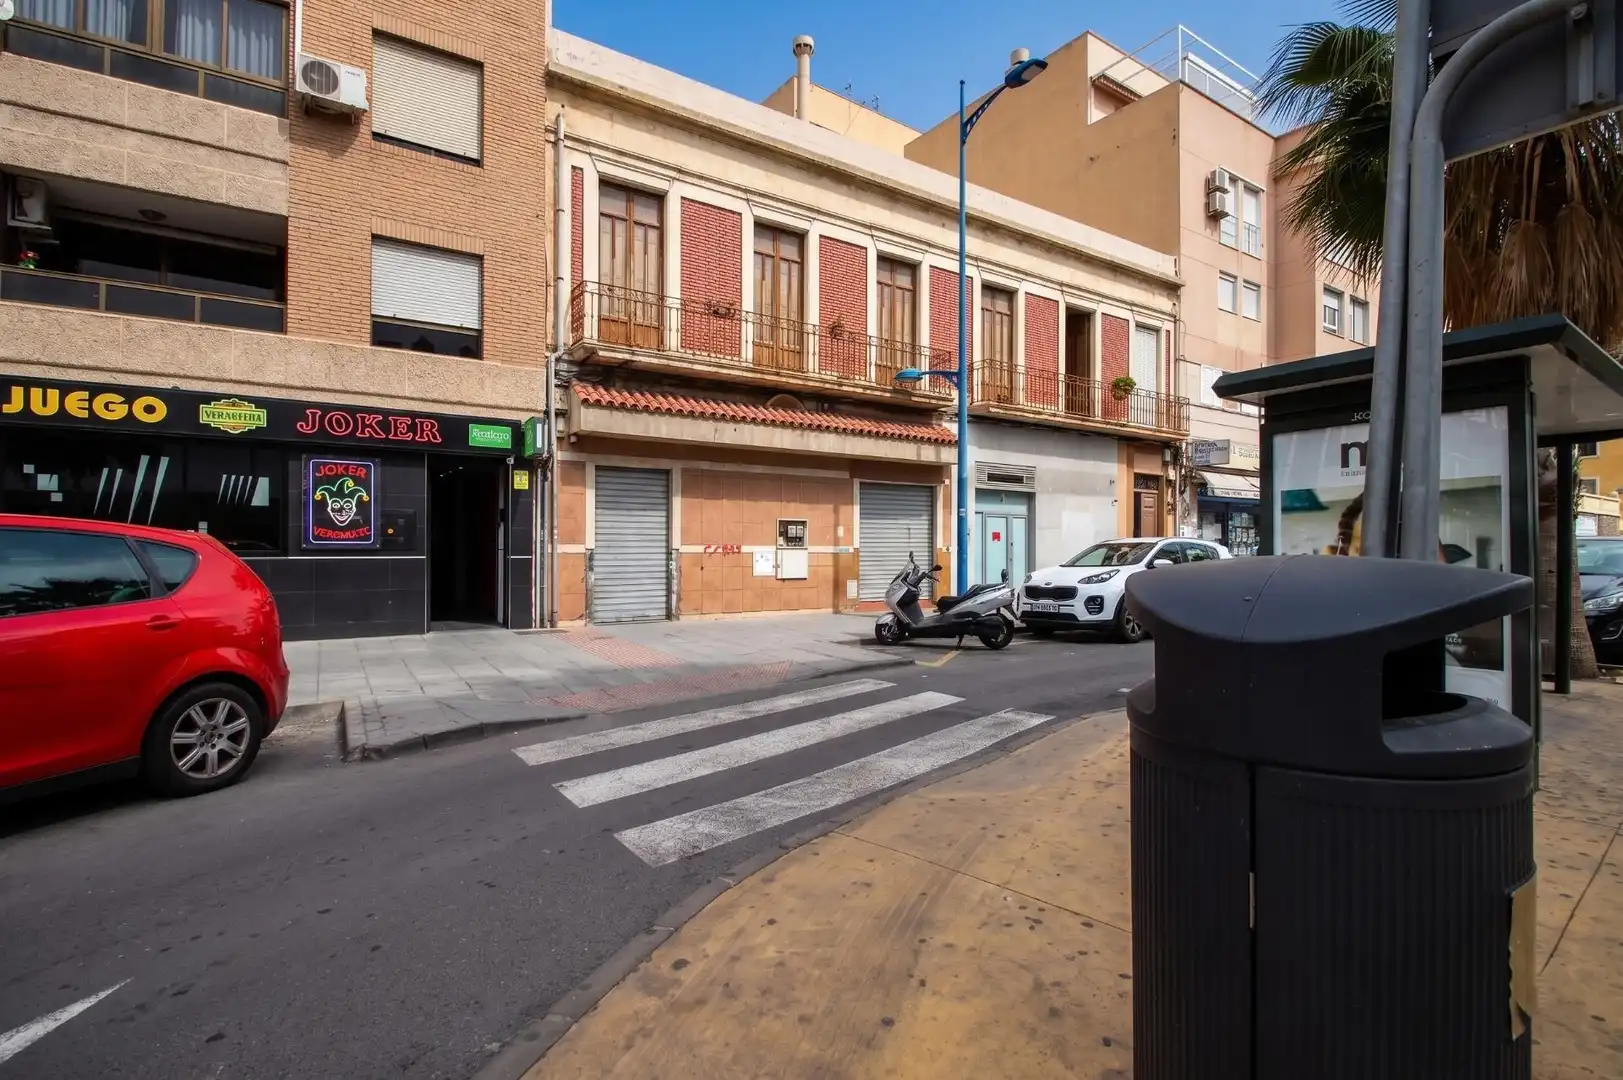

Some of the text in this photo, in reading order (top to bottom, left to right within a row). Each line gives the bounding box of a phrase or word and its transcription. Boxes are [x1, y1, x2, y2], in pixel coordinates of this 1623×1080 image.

[2, 386, 168, 424] JUEGO
[296, 408, 442, 443] JOKER
[315, 463, 368, 478] JOKER
